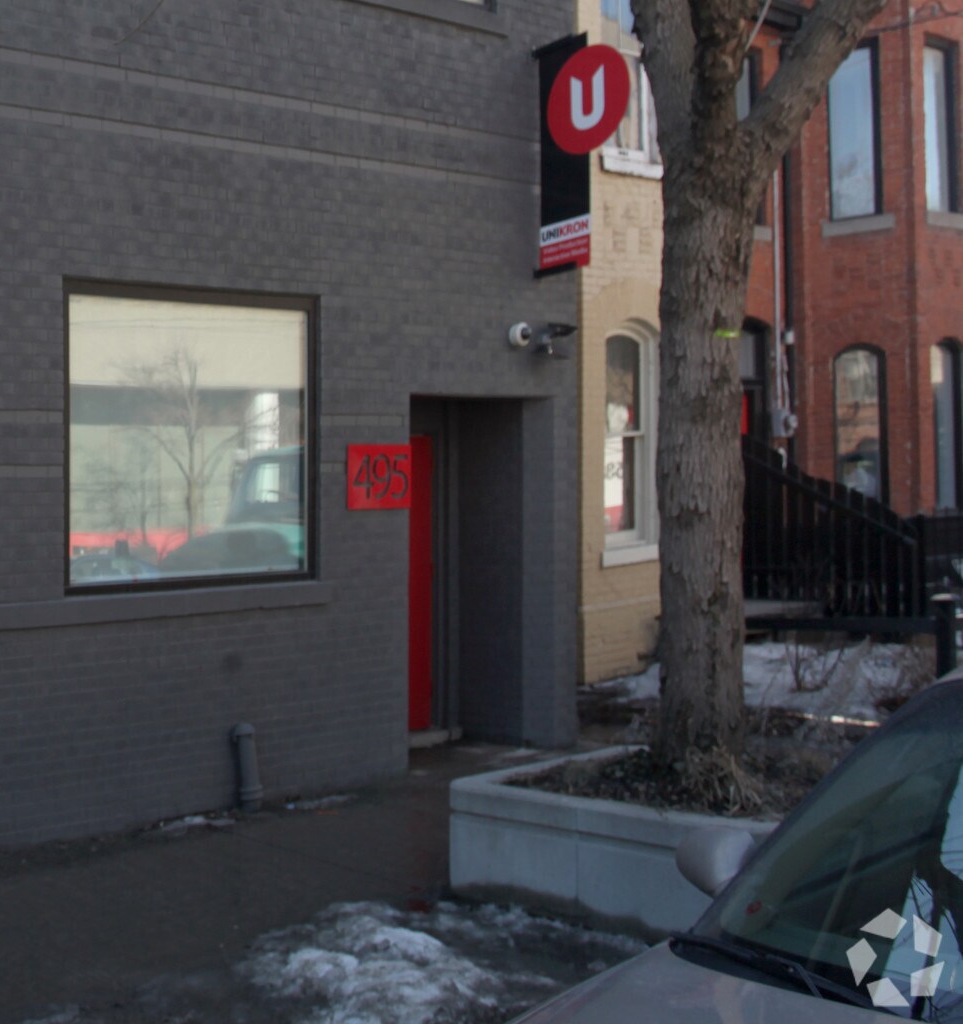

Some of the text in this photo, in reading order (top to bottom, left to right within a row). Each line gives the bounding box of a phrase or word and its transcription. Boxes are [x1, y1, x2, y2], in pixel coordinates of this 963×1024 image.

[570, 64, 606, 131] U
[542, 219, 589, 242] UNIKRON
[353, 453, 409, 500] 495
